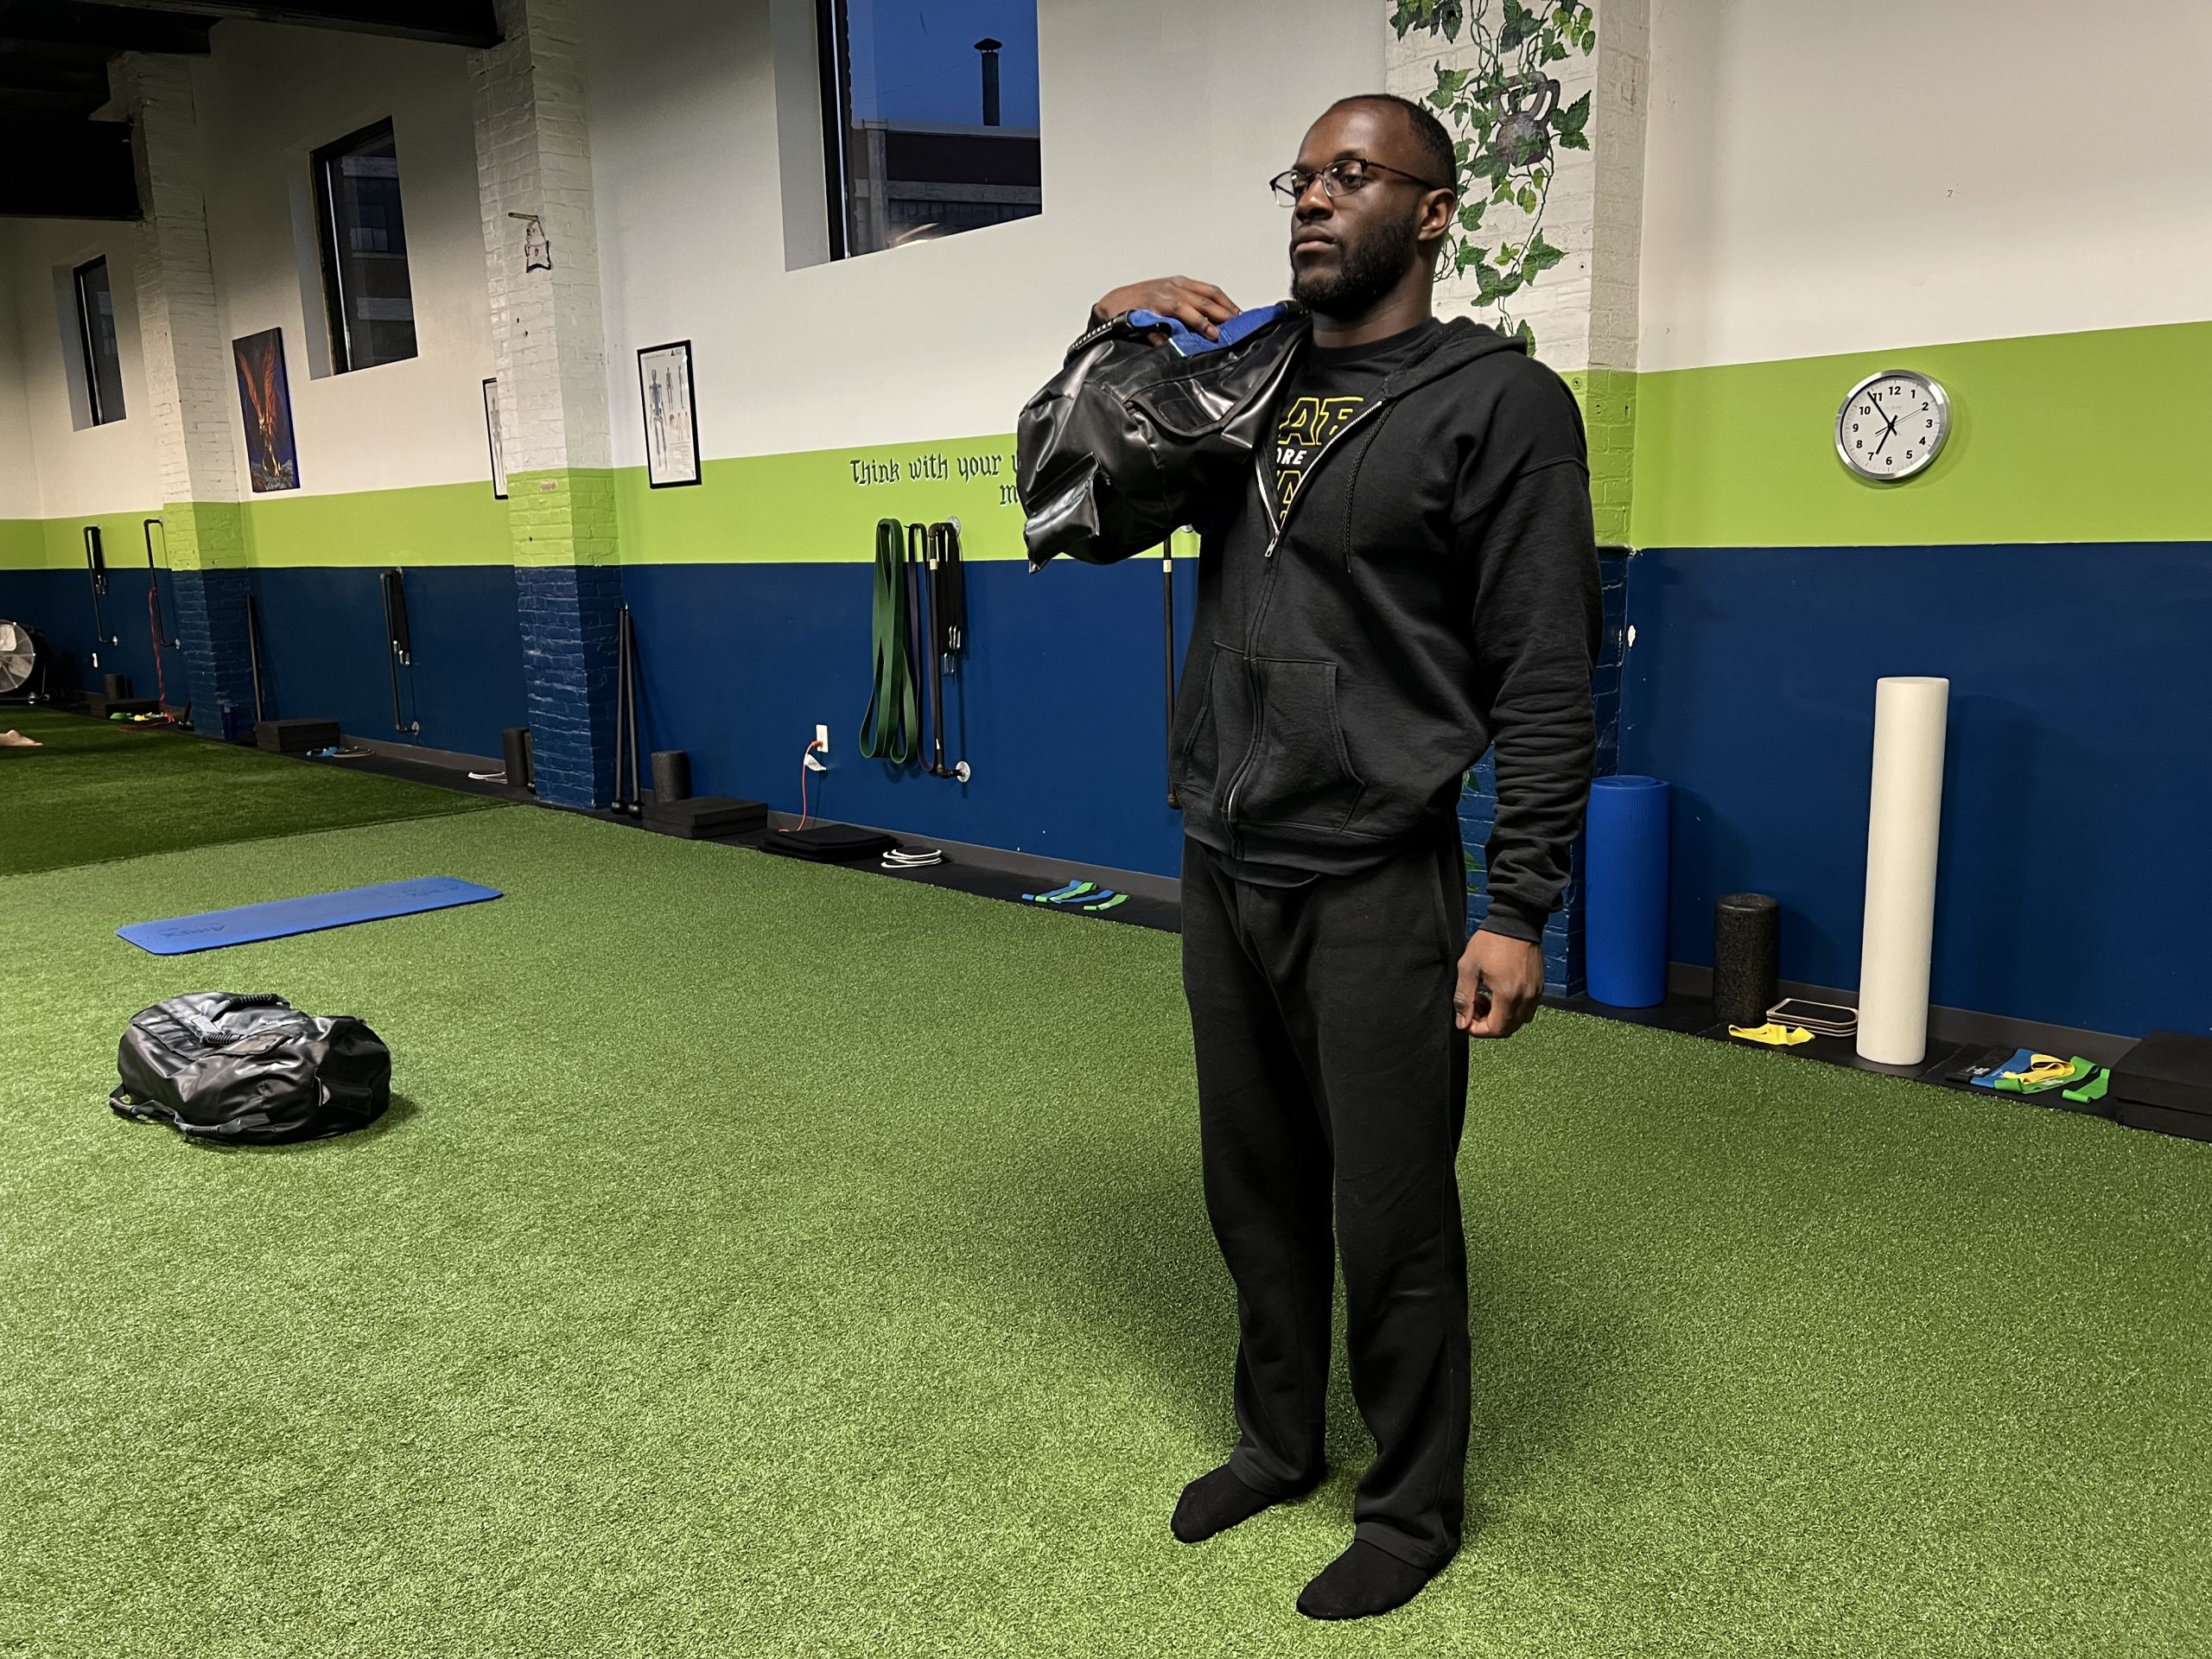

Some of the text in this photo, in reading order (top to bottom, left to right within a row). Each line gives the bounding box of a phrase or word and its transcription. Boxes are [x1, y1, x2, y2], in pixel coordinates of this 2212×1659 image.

[1888, 385, 1901, 396] 12
[1910, 389, 1916, 399] 1
[1872, 392, 1883, 402] 11
[1859, 405, 1871, 416] 10
[1922, 402, 1929, 411] 2
[1853, 423, 1859, 432] 9
[1925, 419, 1933, 429] 3
[1856, 439, 1863, 448] 8
[1918, 436, 1926, 446] 4
[1867, 452, 1874, 461] 7
[1905, 450, 1913, 460] 5
[1885, 456, 1892, 465] 6
[849, 458, 900, 486] Think
[909, 453, 949, 480] with
[957, 454, 1002, 483] your
